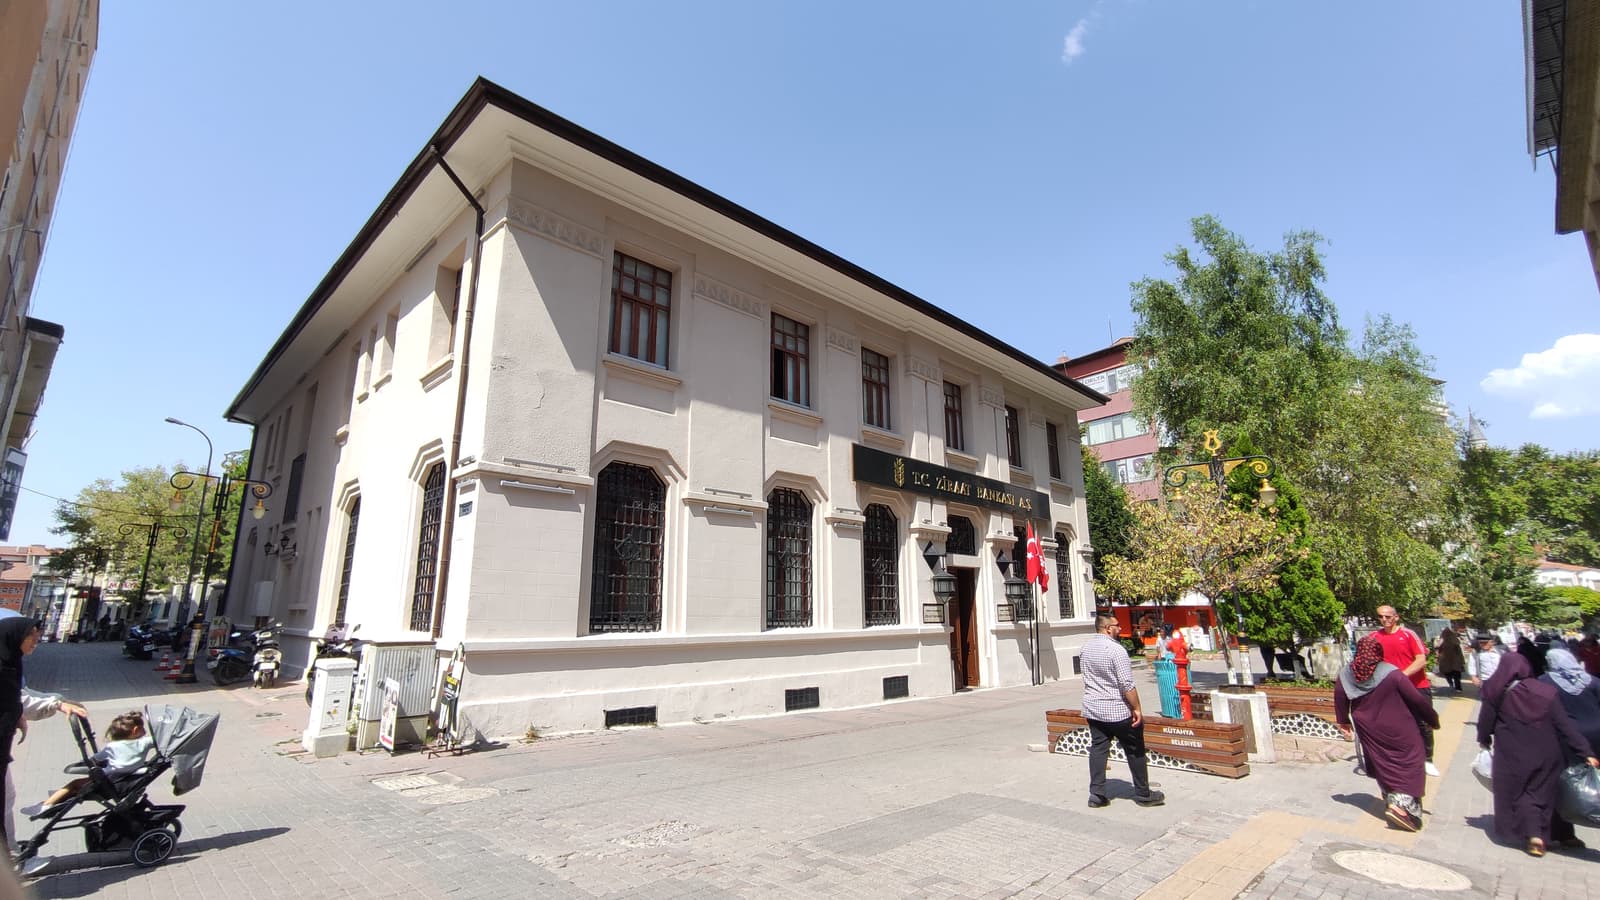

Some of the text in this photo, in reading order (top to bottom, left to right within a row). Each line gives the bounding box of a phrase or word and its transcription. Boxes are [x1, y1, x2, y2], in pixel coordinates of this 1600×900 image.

[936, 475, 970, 496] ZİRAAT
[977, 487, 1015, 505] BANKASI
[1163, 726, 1194, 736] KÜTAHYA
